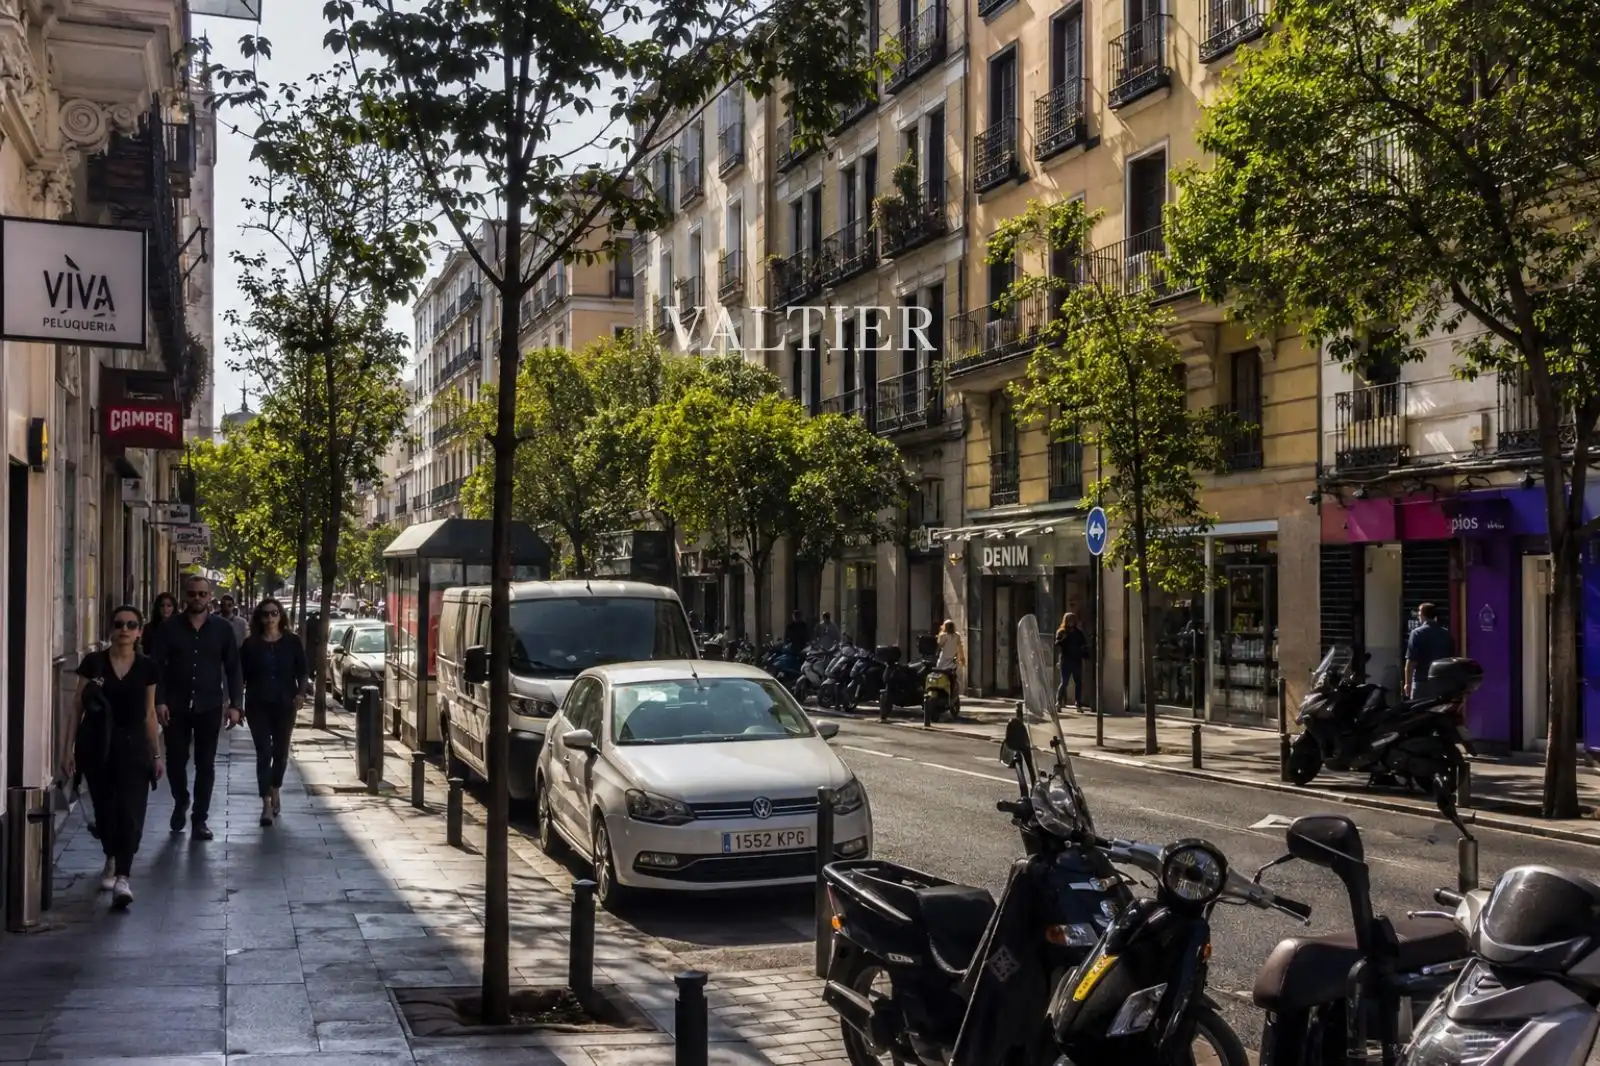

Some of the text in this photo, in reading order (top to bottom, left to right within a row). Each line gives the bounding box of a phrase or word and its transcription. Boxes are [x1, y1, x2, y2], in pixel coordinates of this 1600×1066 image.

[42, 317, 117, 332] PELUQUERIA
[110, 409, 174, 435] CAMPER
[983, 545, 1029, 567] DENIM
[735, 830, 805, 850] 1552 KPG
